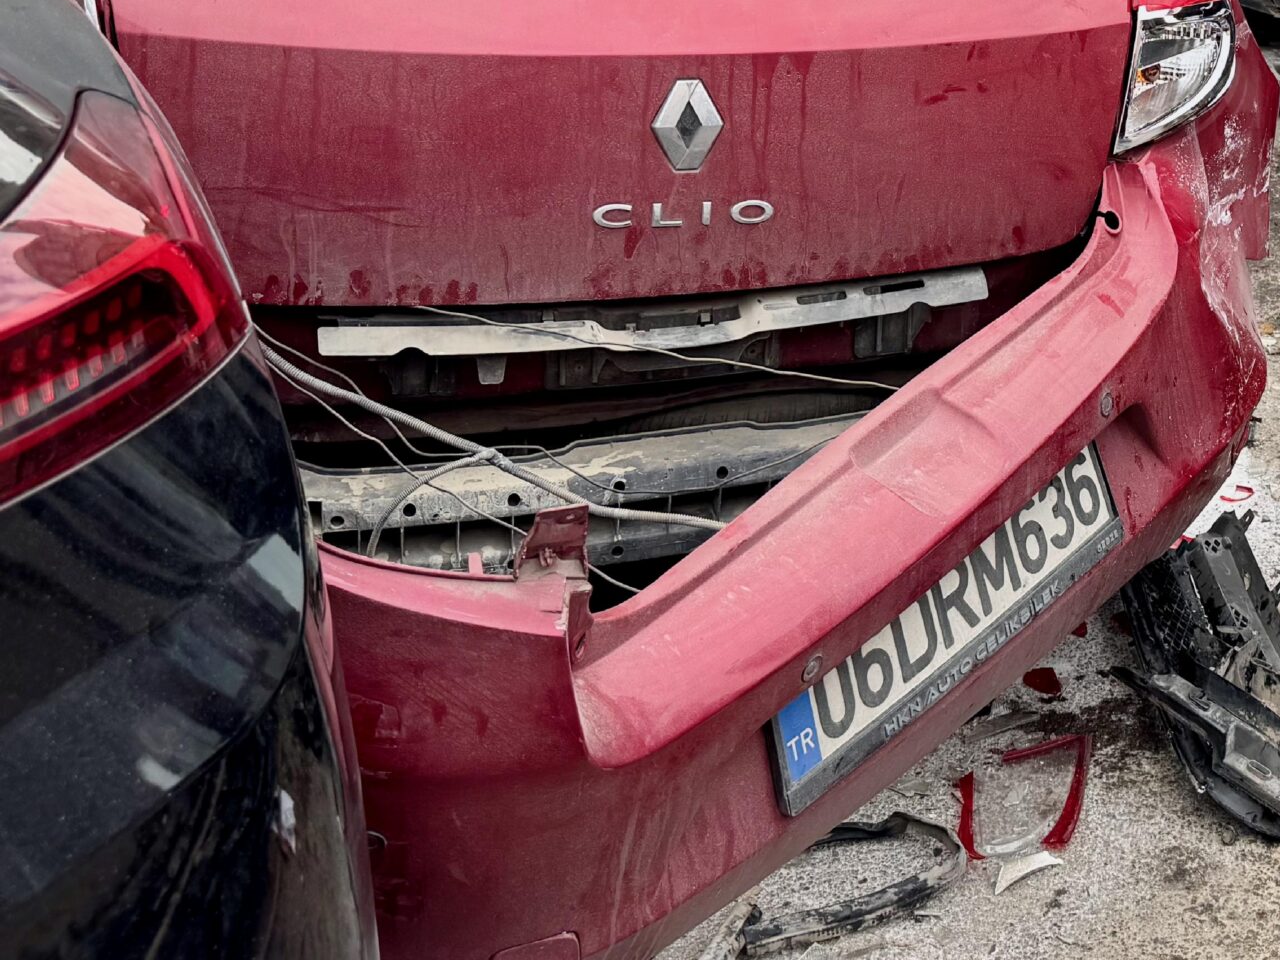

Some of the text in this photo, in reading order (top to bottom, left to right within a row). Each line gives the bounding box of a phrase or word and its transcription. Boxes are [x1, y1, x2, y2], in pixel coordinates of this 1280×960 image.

[592, 199, 775, 229] CLIO
[883, 696, 922, 739] HKN
[923, 657, 974, 707] AUTO
[786, 726, 816, 763] TR
